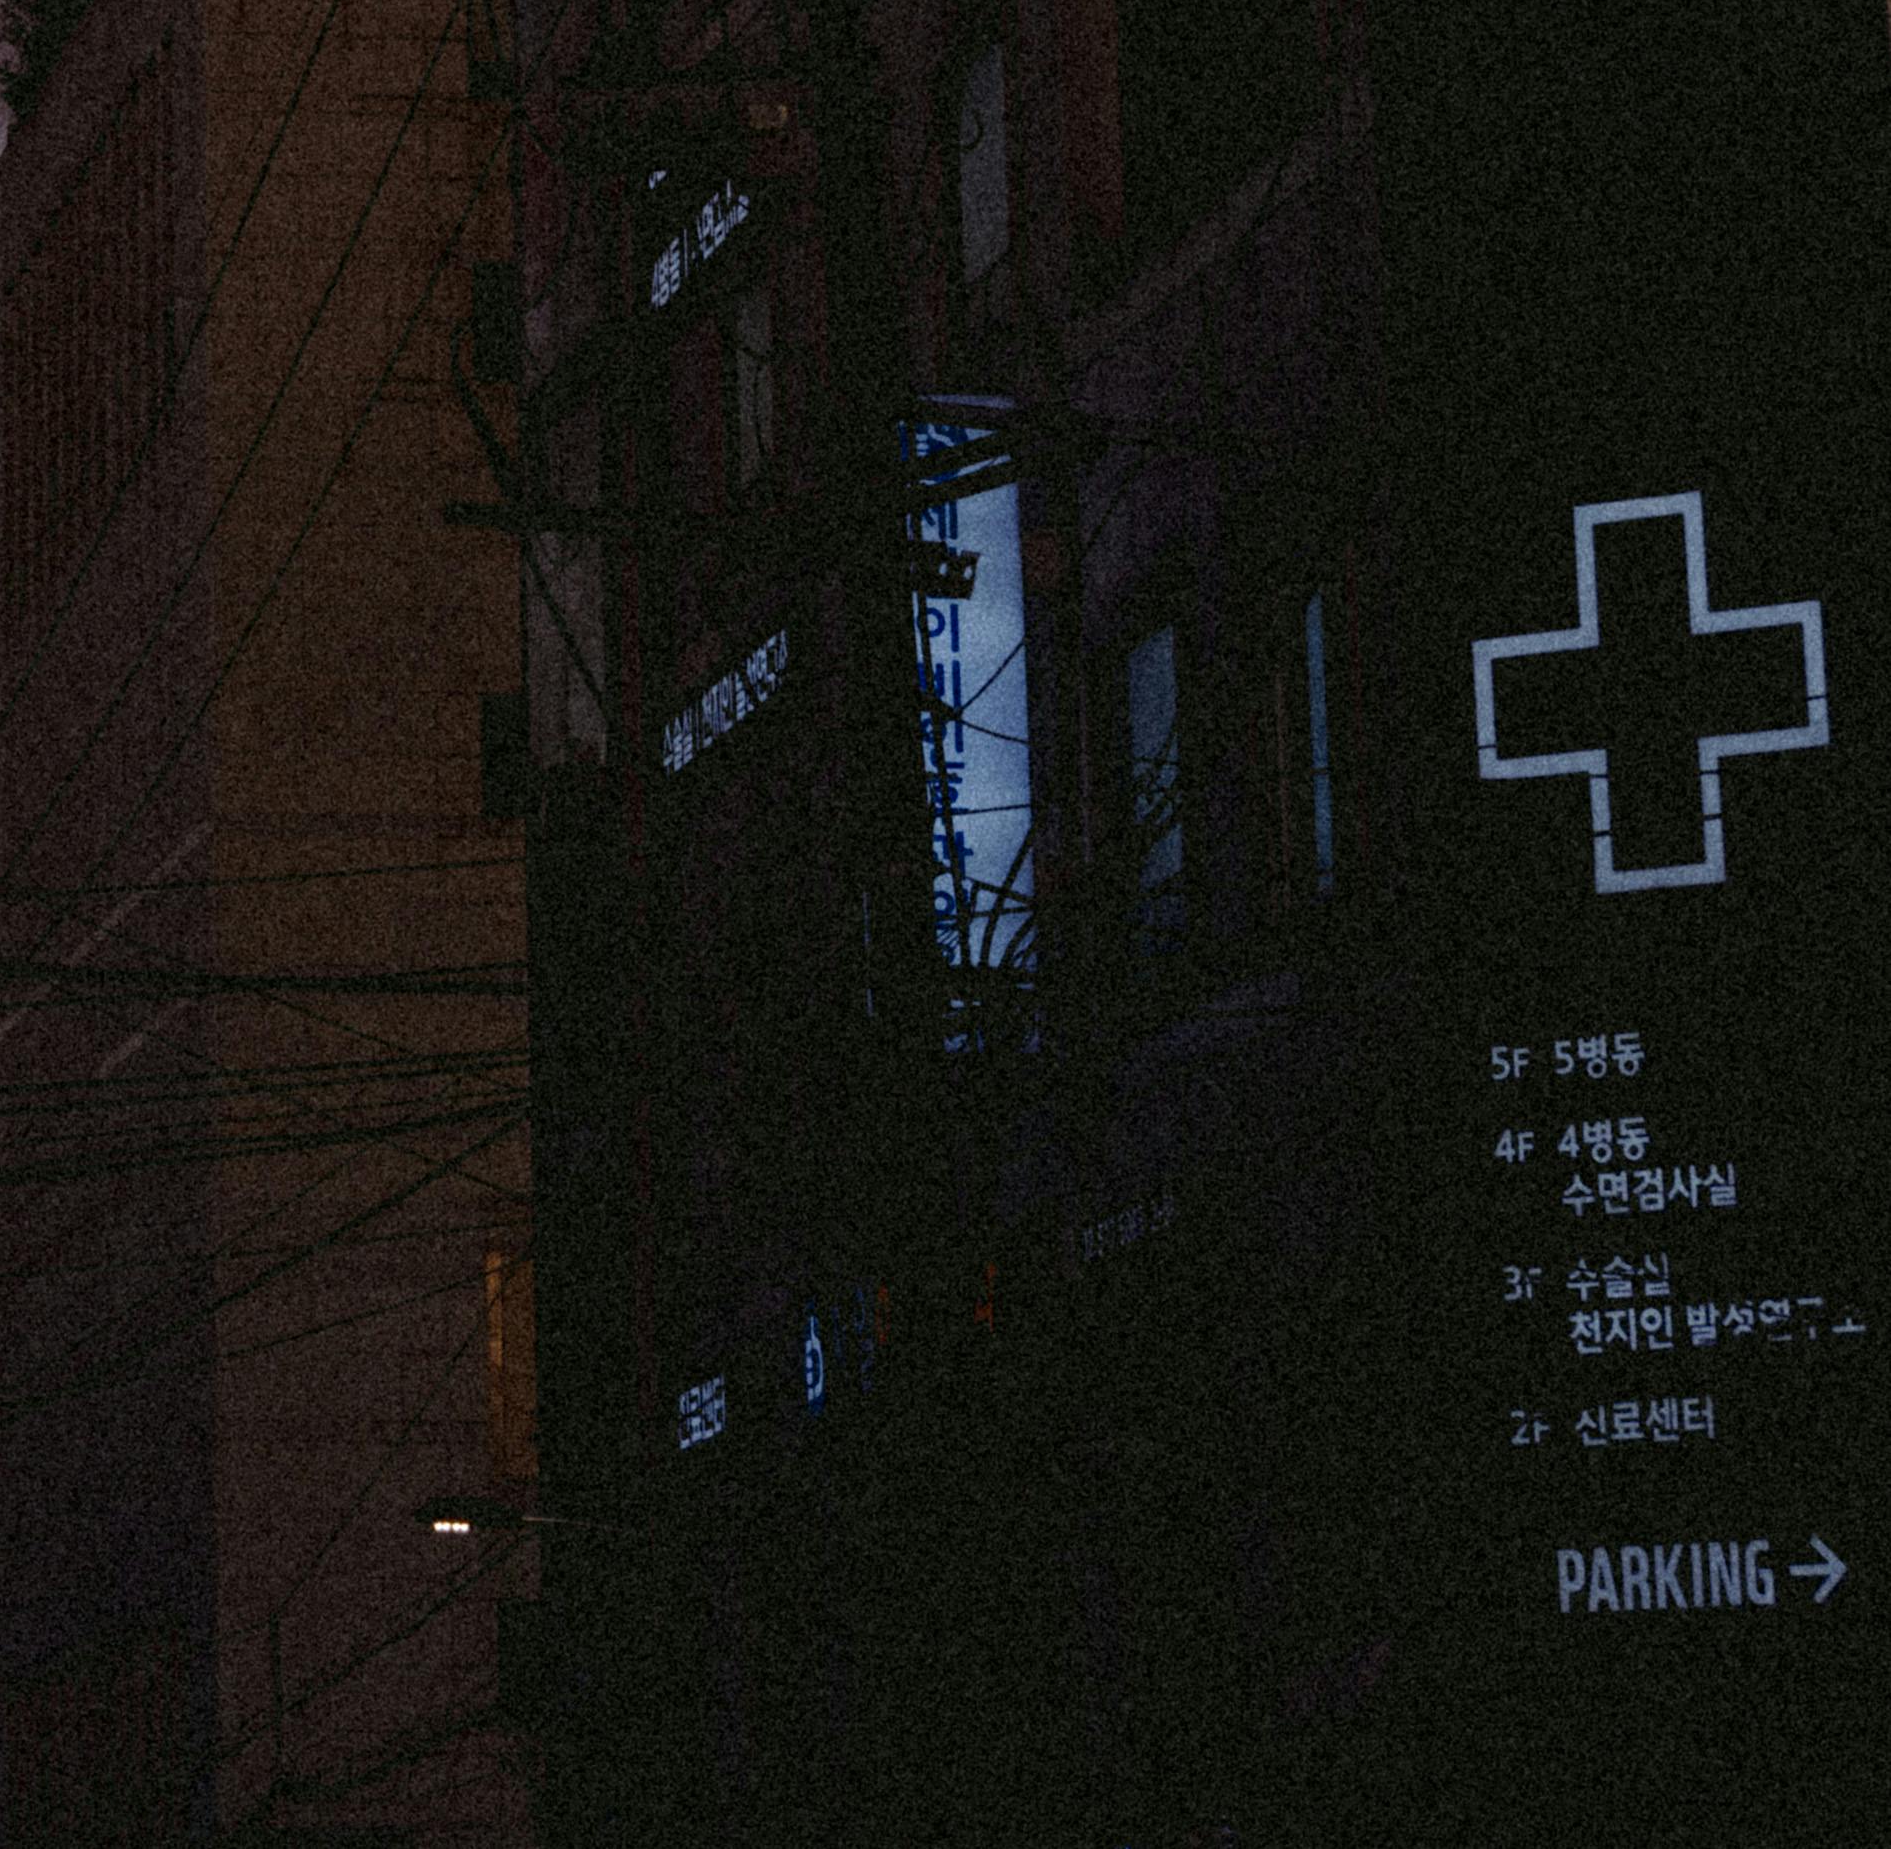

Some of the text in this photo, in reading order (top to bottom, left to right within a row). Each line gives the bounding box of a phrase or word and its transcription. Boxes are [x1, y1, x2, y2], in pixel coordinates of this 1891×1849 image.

[1489, 1031, 1647, 1082] 5F 5병동
[1493, 1115, 1651, 1165] 4F 4병동
[1561, 1163, 1739, 1218] 수면검사실
[1502, 1264, 1544, 1302] 3F
[1567, 1307, 1675, 1357] 천지인
[1510, 1408, 1552, 1446] 2F
[1556, 1538, 1777, 1614] PARKING
